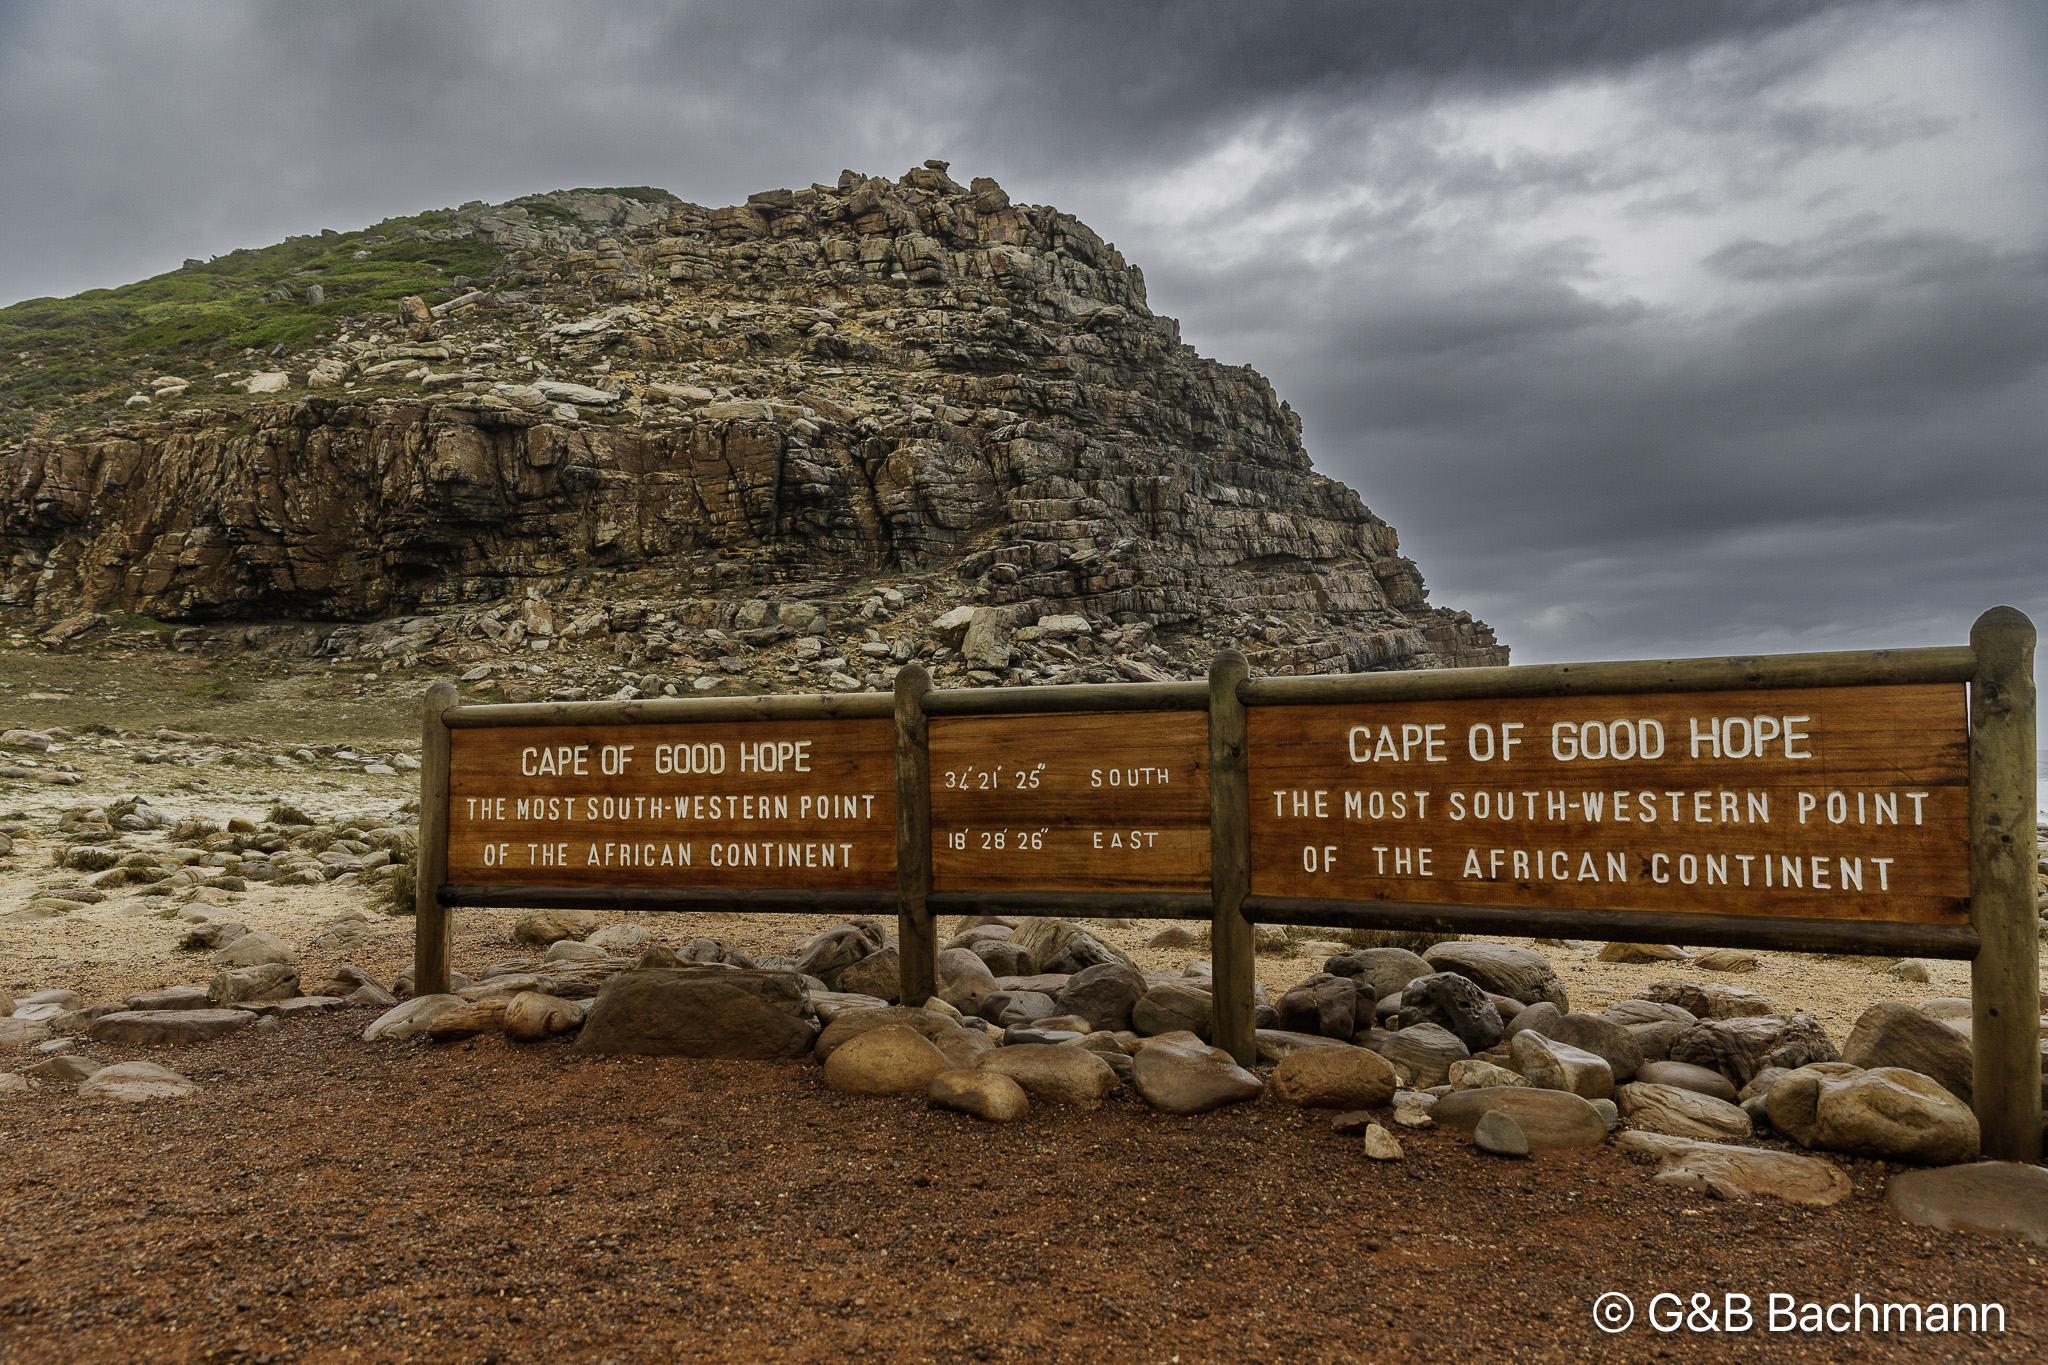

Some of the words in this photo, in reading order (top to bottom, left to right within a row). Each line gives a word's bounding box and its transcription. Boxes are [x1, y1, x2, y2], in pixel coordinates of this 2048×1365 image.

[1348, 723, 1448, 763] CAPE
[1468, 722, 1525, 762] OF
[1551, 718, 1665, 762] GOOD
[1689, 715, 1813, 760] HOPE
[521, 745, 589, 776] CAPE
[601, 745, 635, 776] OF
[655, 742, 726, 775] GOOD
[740, 740, 812, 773] HOPE
[1091, 767, 1169, 788] SOUTH
[466, 797, 506, 821] THE
[517, 797, 576, 821] MOST
[586, 795, 788, 820] SOUTH-WESTERN
[800, 794, 875, 820] POINT
[1273, 790, 1329, 818] THE
[1344, 790, 1430, 820] MOST
[1449, 790, 1770, 824] SOUTH-WESTERN
[1798, 790, 1929, 826] POINT
[483, 843, 510, 867] OF
[527, 842, 569, 866] THE
[587, 842, 691, 867] AFRICAN
[710, 842, 853, 868] CONTINENT
[1093, 830, 1159, 850] EAST
[1303, 845, 1338, 873] OF
[1371, 847, 1434, 876] THE
[1462, 848, 1627, 883] AFRICAN
[1651, 852, 1895, 891] CONTINENT
